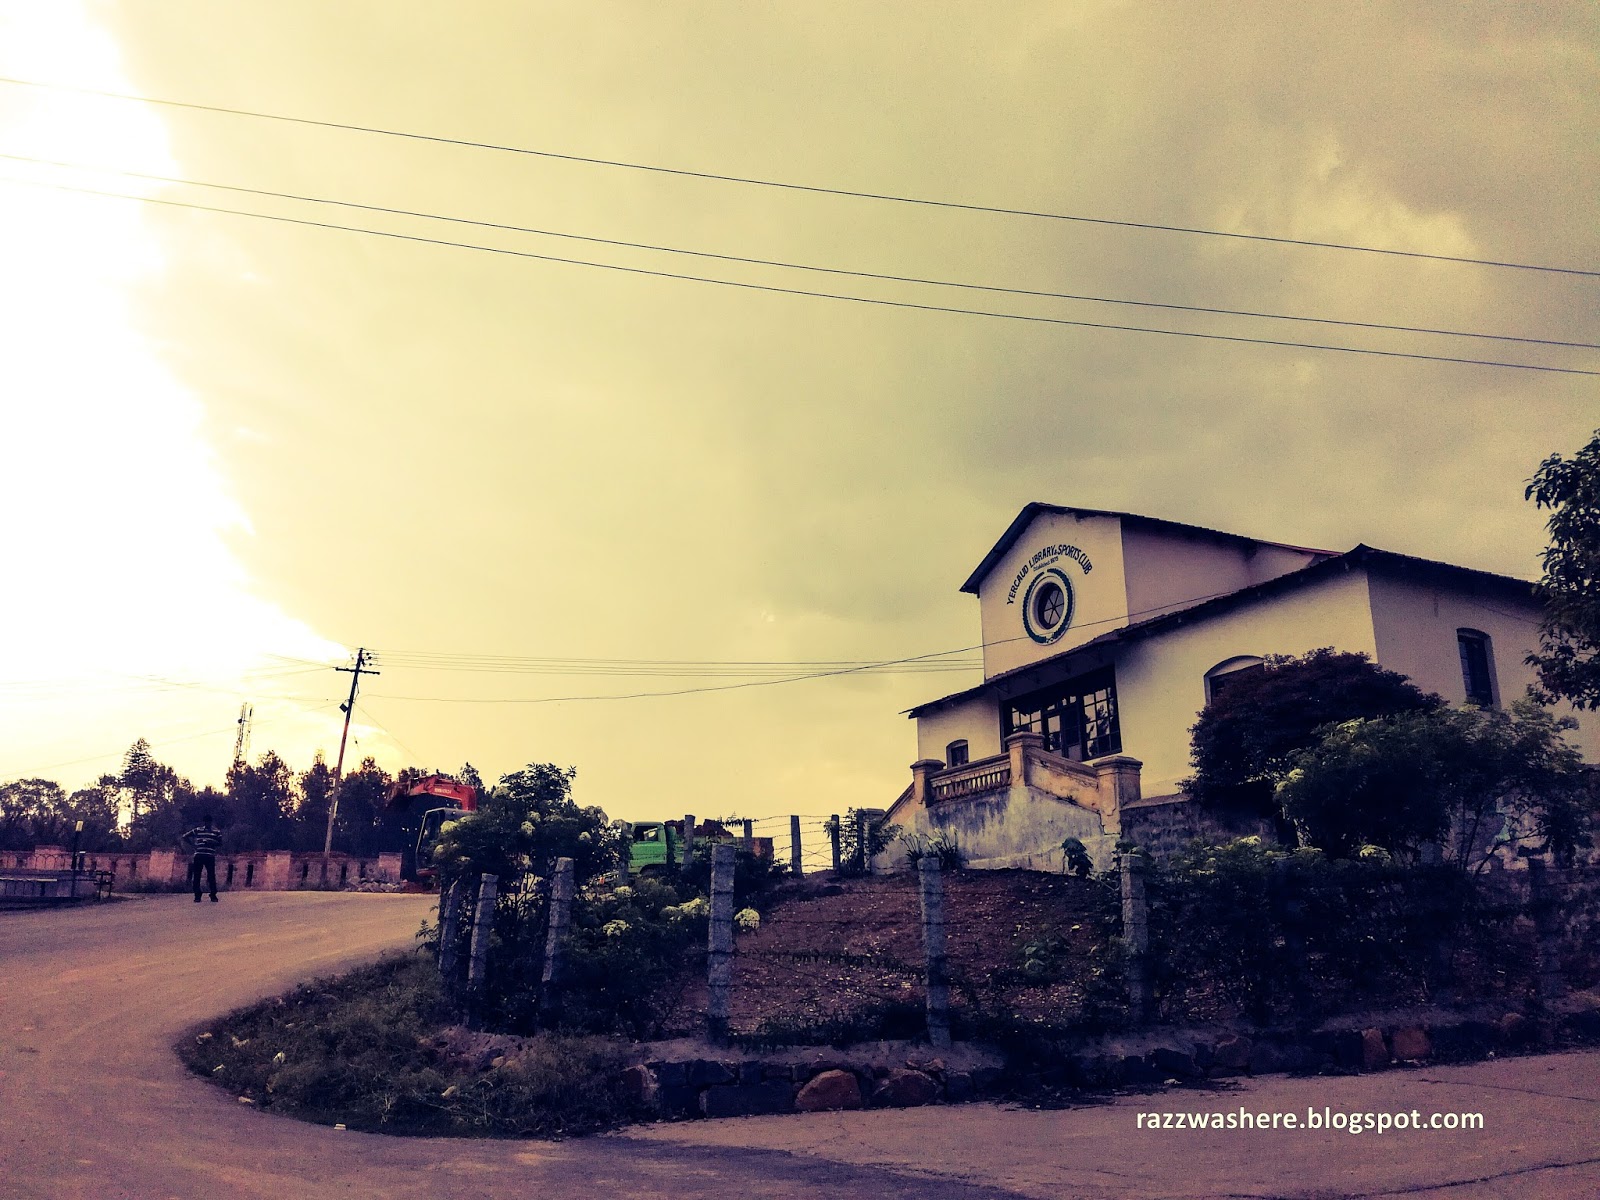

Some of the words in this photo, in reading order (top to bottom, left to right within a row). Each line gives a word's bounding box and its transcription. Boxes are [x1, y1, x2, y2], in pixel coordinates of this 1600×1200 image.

[1007, 564, 1029, 605] YERCAUD
[1028, 545, 1056, 568] LIBRARY
[1057, 544, 1081, 560] SPORTS
[1078, 553, 1093, 575] CLUB
